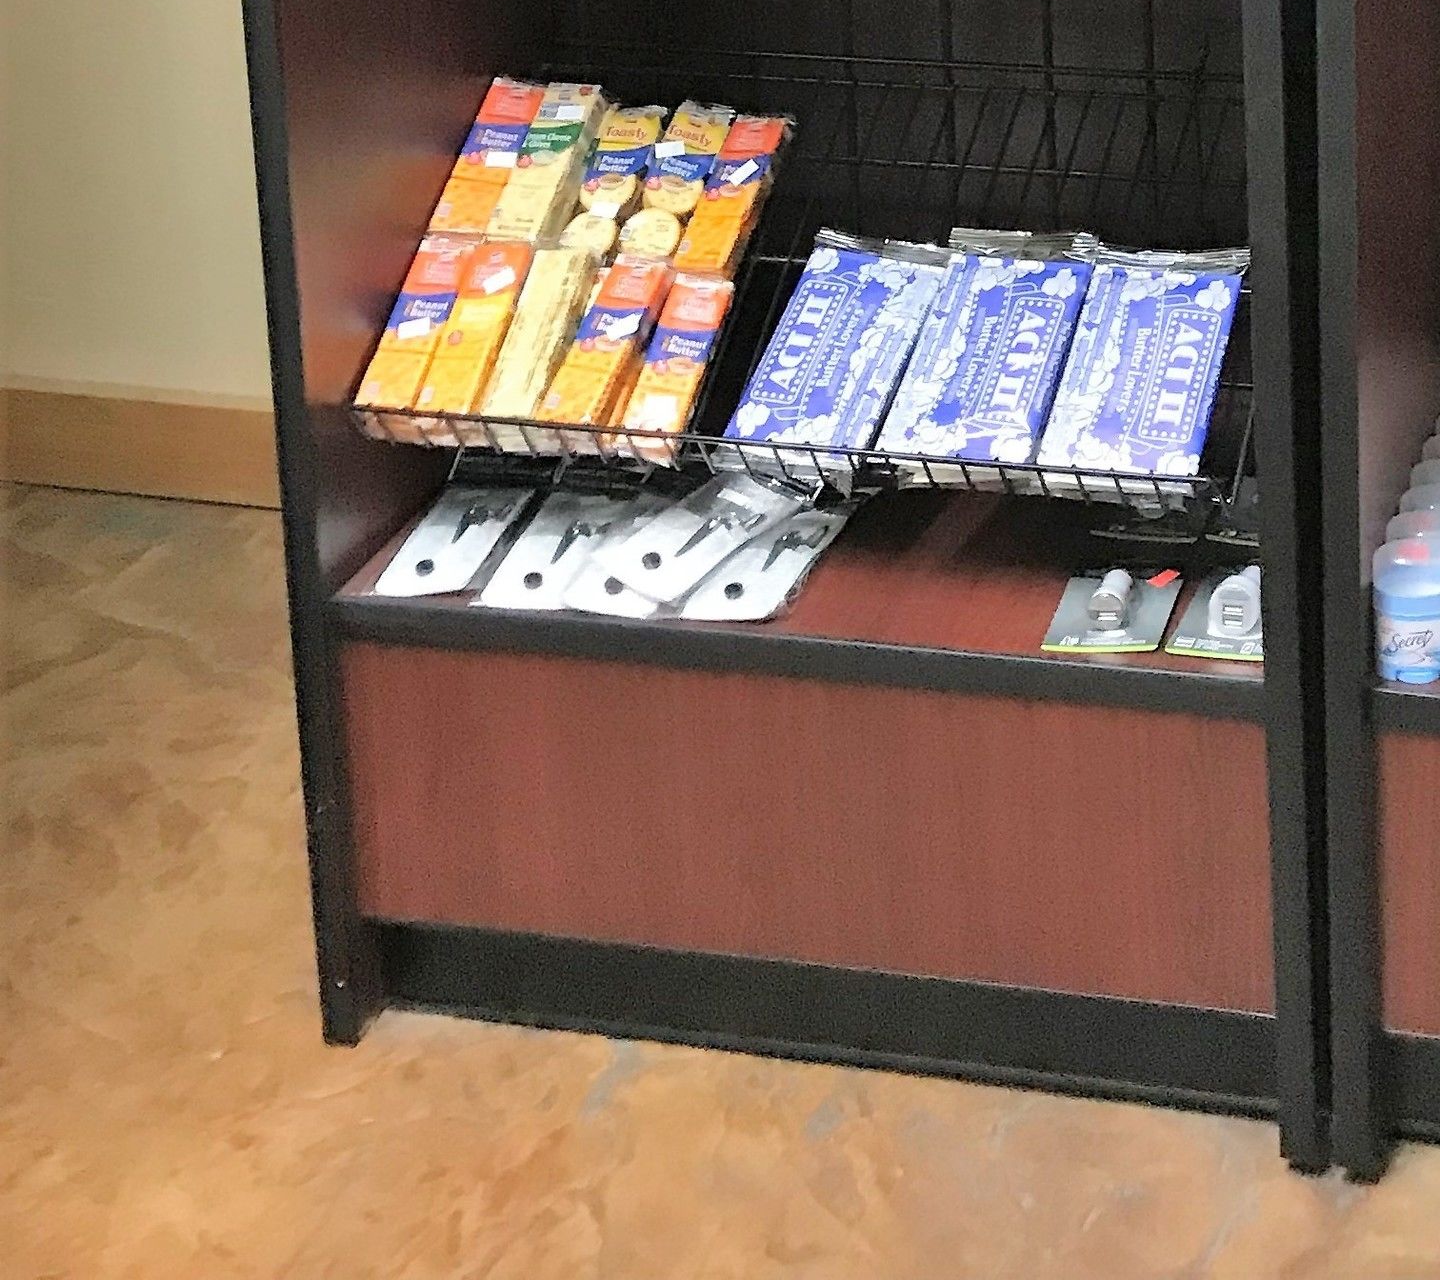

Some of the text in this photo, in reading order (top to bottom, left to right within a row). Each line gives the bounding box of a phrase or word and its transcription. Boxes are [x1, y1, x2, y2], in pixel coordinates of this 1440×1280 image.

[485, 128, 519, 142] Peanut
[606, 126, 648, 140] Toasty
[668, 125, 712, 147] Toasty
[598, 163, 630, 173] Butter
[601, 155, 636, 166] Peanut
[414, 298, 450, 312] Peanut
[666, 342, 702, 358] Butter
[670, 334, 708, 351] Peanut
[768, 294, 833, 390] ACT II
[957, 316, 999, 398] Butter Lovers
[815, 347, 843, 387] Butter
[1116, 327, 1153, 413] Butter Lovers
[1153, 322, 1204, 426] ACT II
[1383, 629, 1434, 656] Secret
